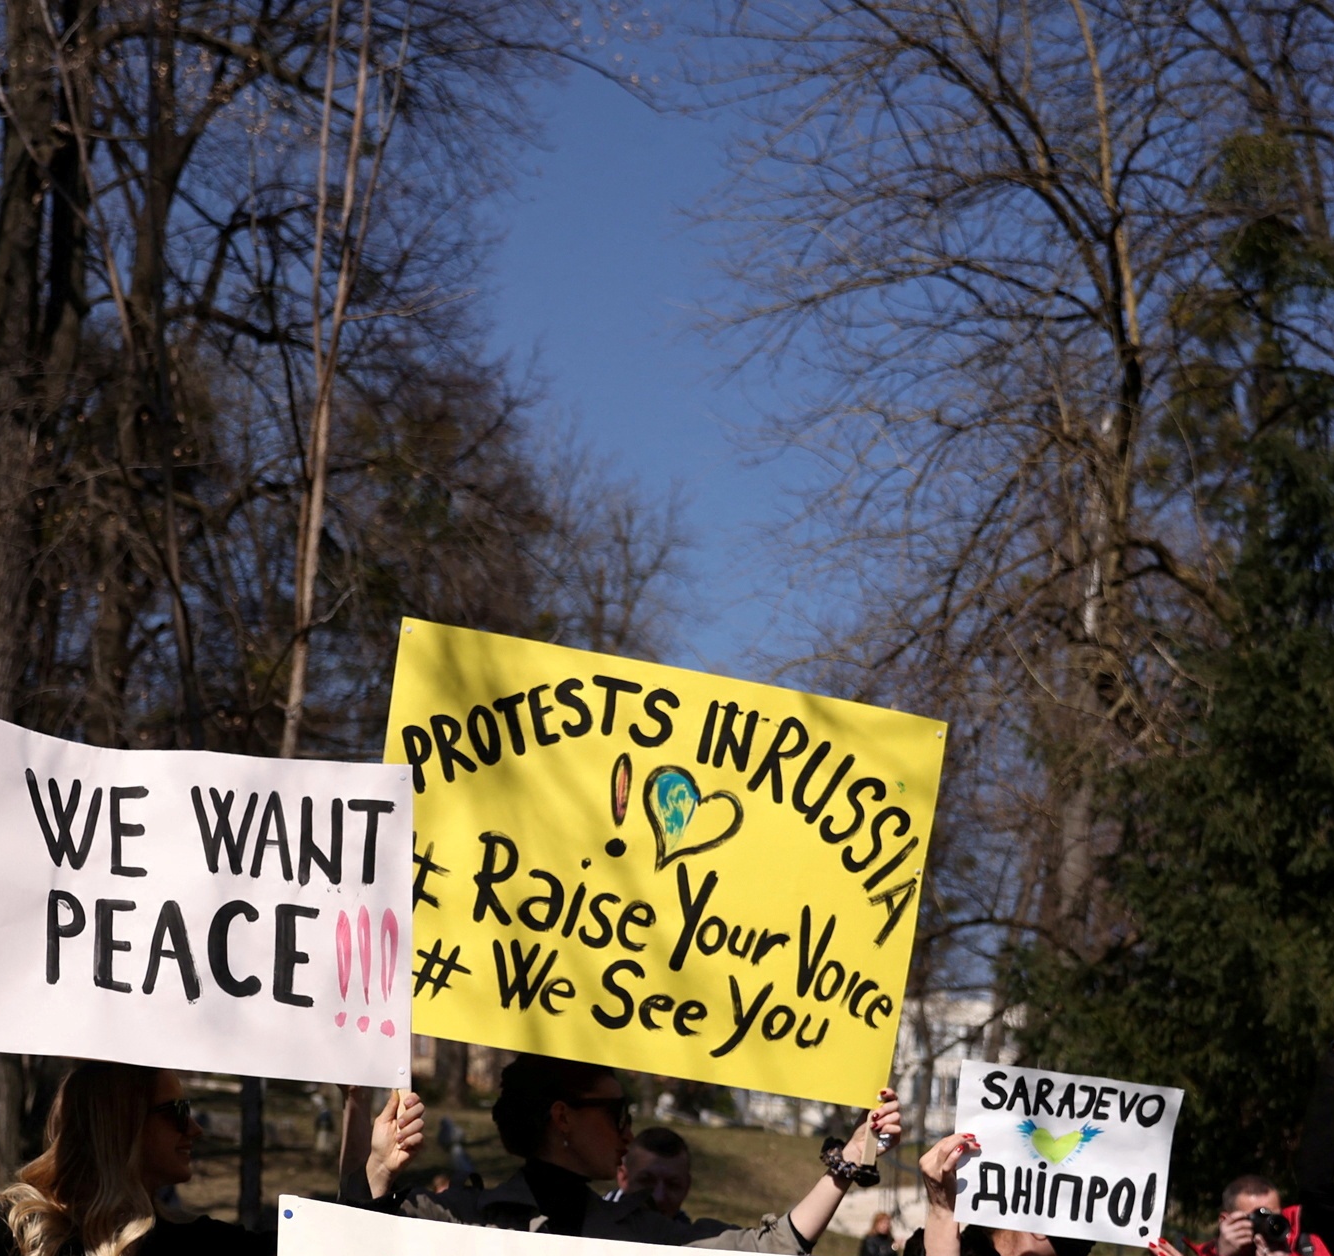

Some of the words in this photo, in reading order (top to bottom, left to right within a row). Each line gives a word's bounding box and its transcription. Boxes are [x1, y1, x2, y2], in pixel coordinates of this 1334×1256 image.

[401, 674, 680, 793] PROTESTS
[25, 768, 149, 877] WE
[190, 785, 395, 886] WANT
[45, 889, 399, 1038] PEACE!!!
[472, 831, 656, 951] Raise
[669, 863, 790, 972] Your
[796, 904, 895, 1030] Voice
[492, 939, 576, 1016] We
[591, 959, 708, 1037] See
[710, 974, 830, 1058] You
[980, 1071, 1166, 1128] SARAJEVO
